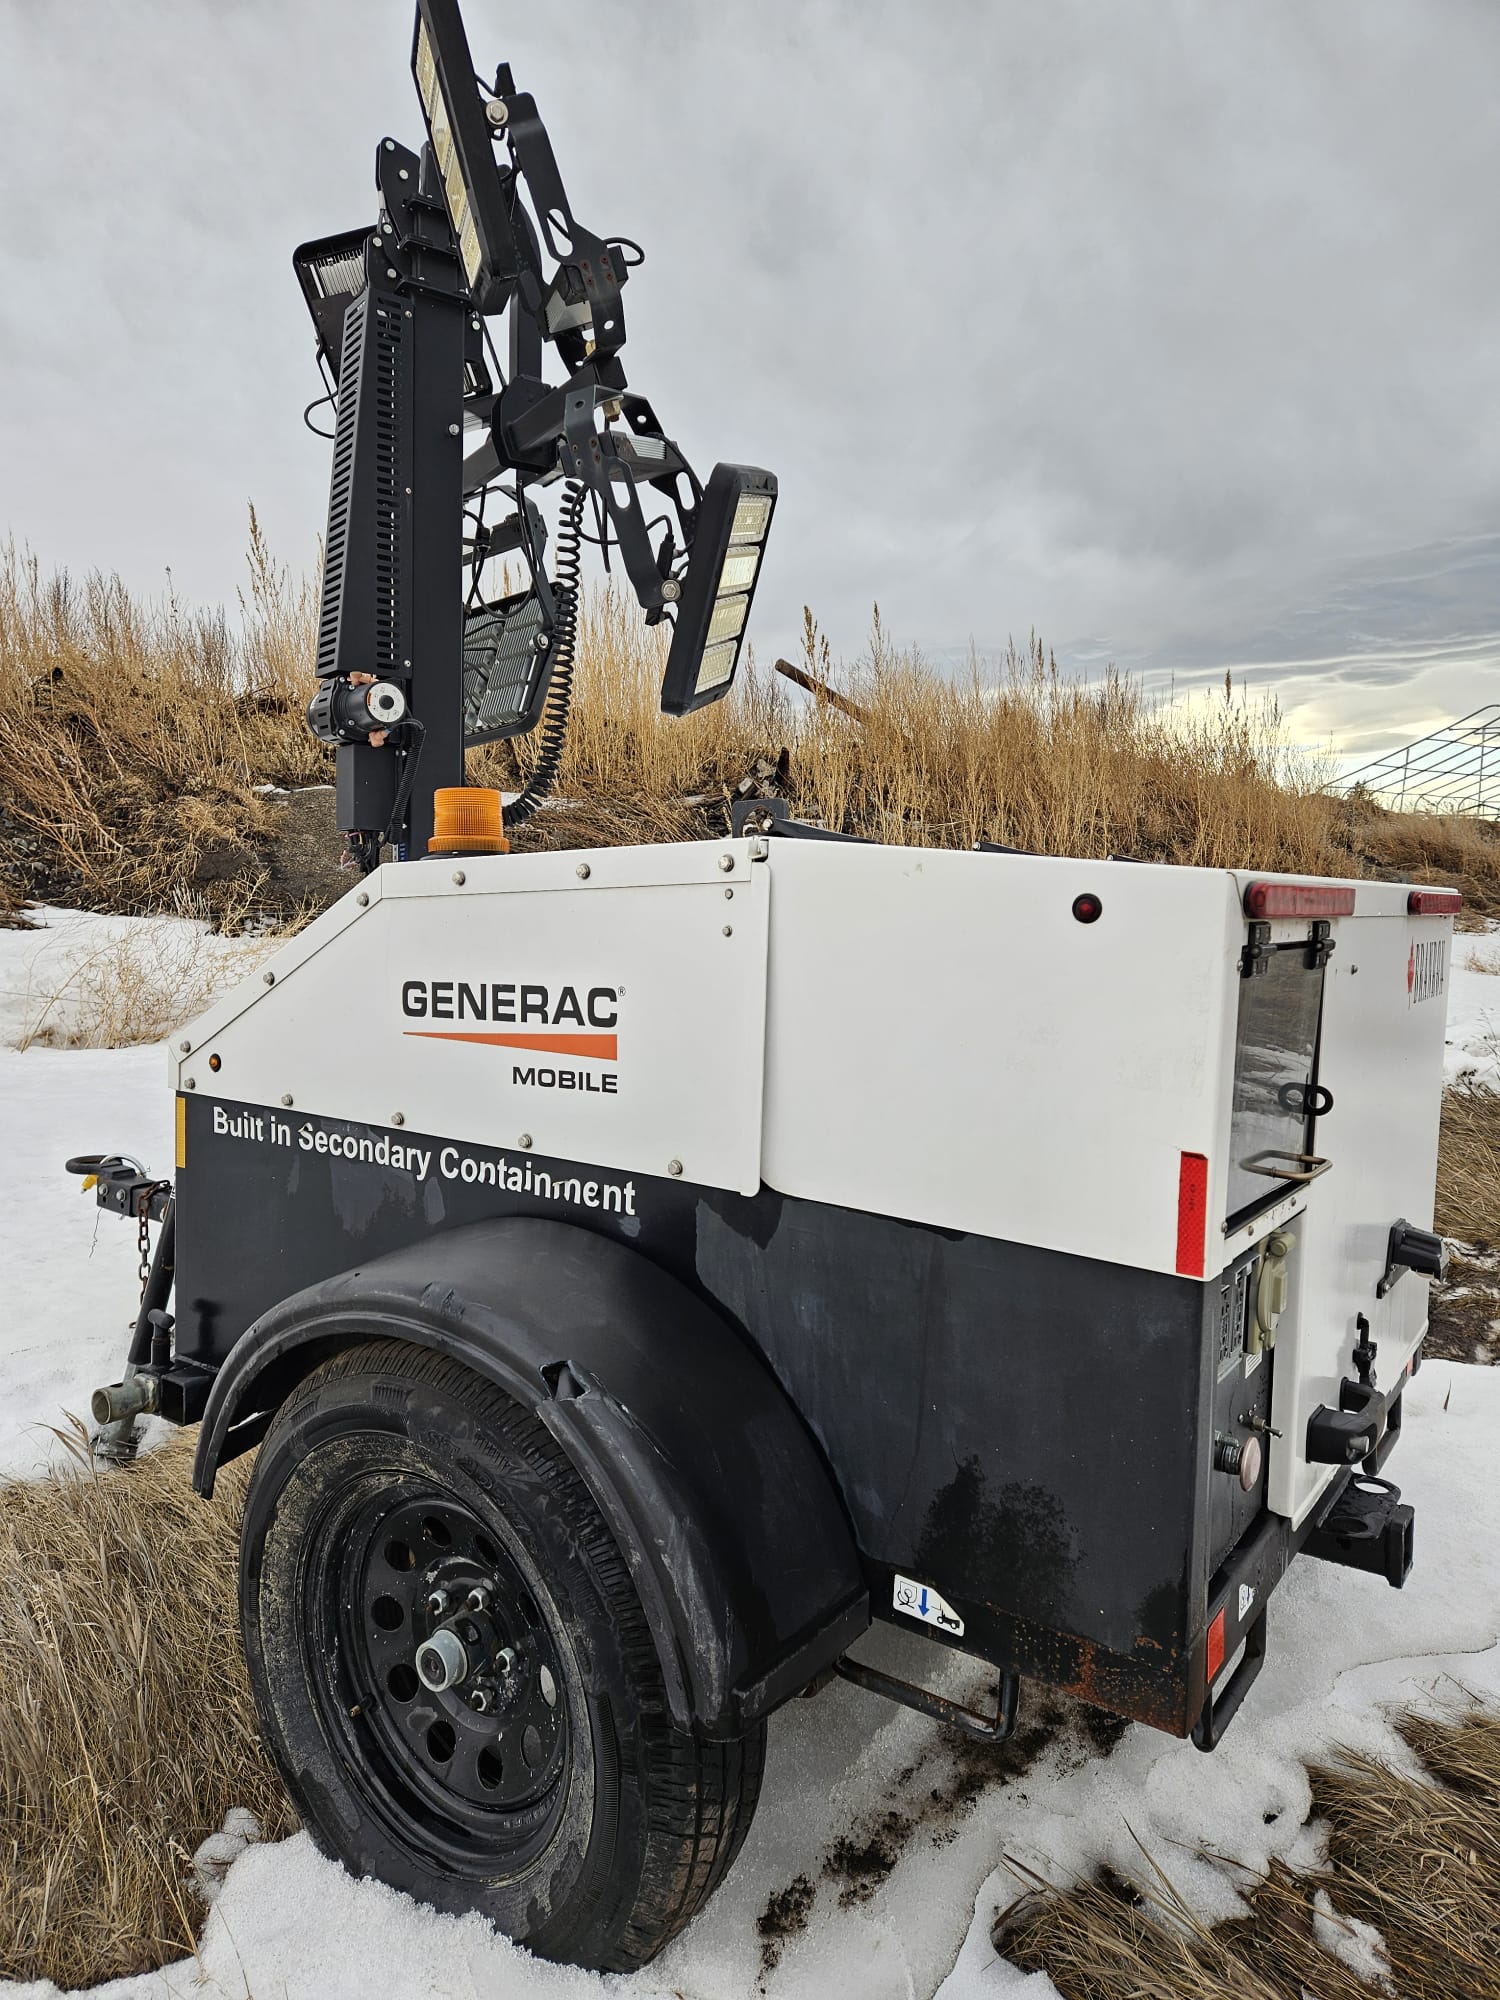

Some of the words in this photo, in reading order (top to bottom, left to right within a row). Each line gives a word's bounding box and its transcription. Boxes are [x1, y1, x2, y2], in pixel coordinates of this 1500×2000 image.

[513, 1067, 617, 1093] MOBILE
[213, 1106, 264, 1141] Built
[271, 1116, 290, 1146] in
[298, 1123, 431, 1180] Secondary
[440, 1148, 635, 1215] Containment
